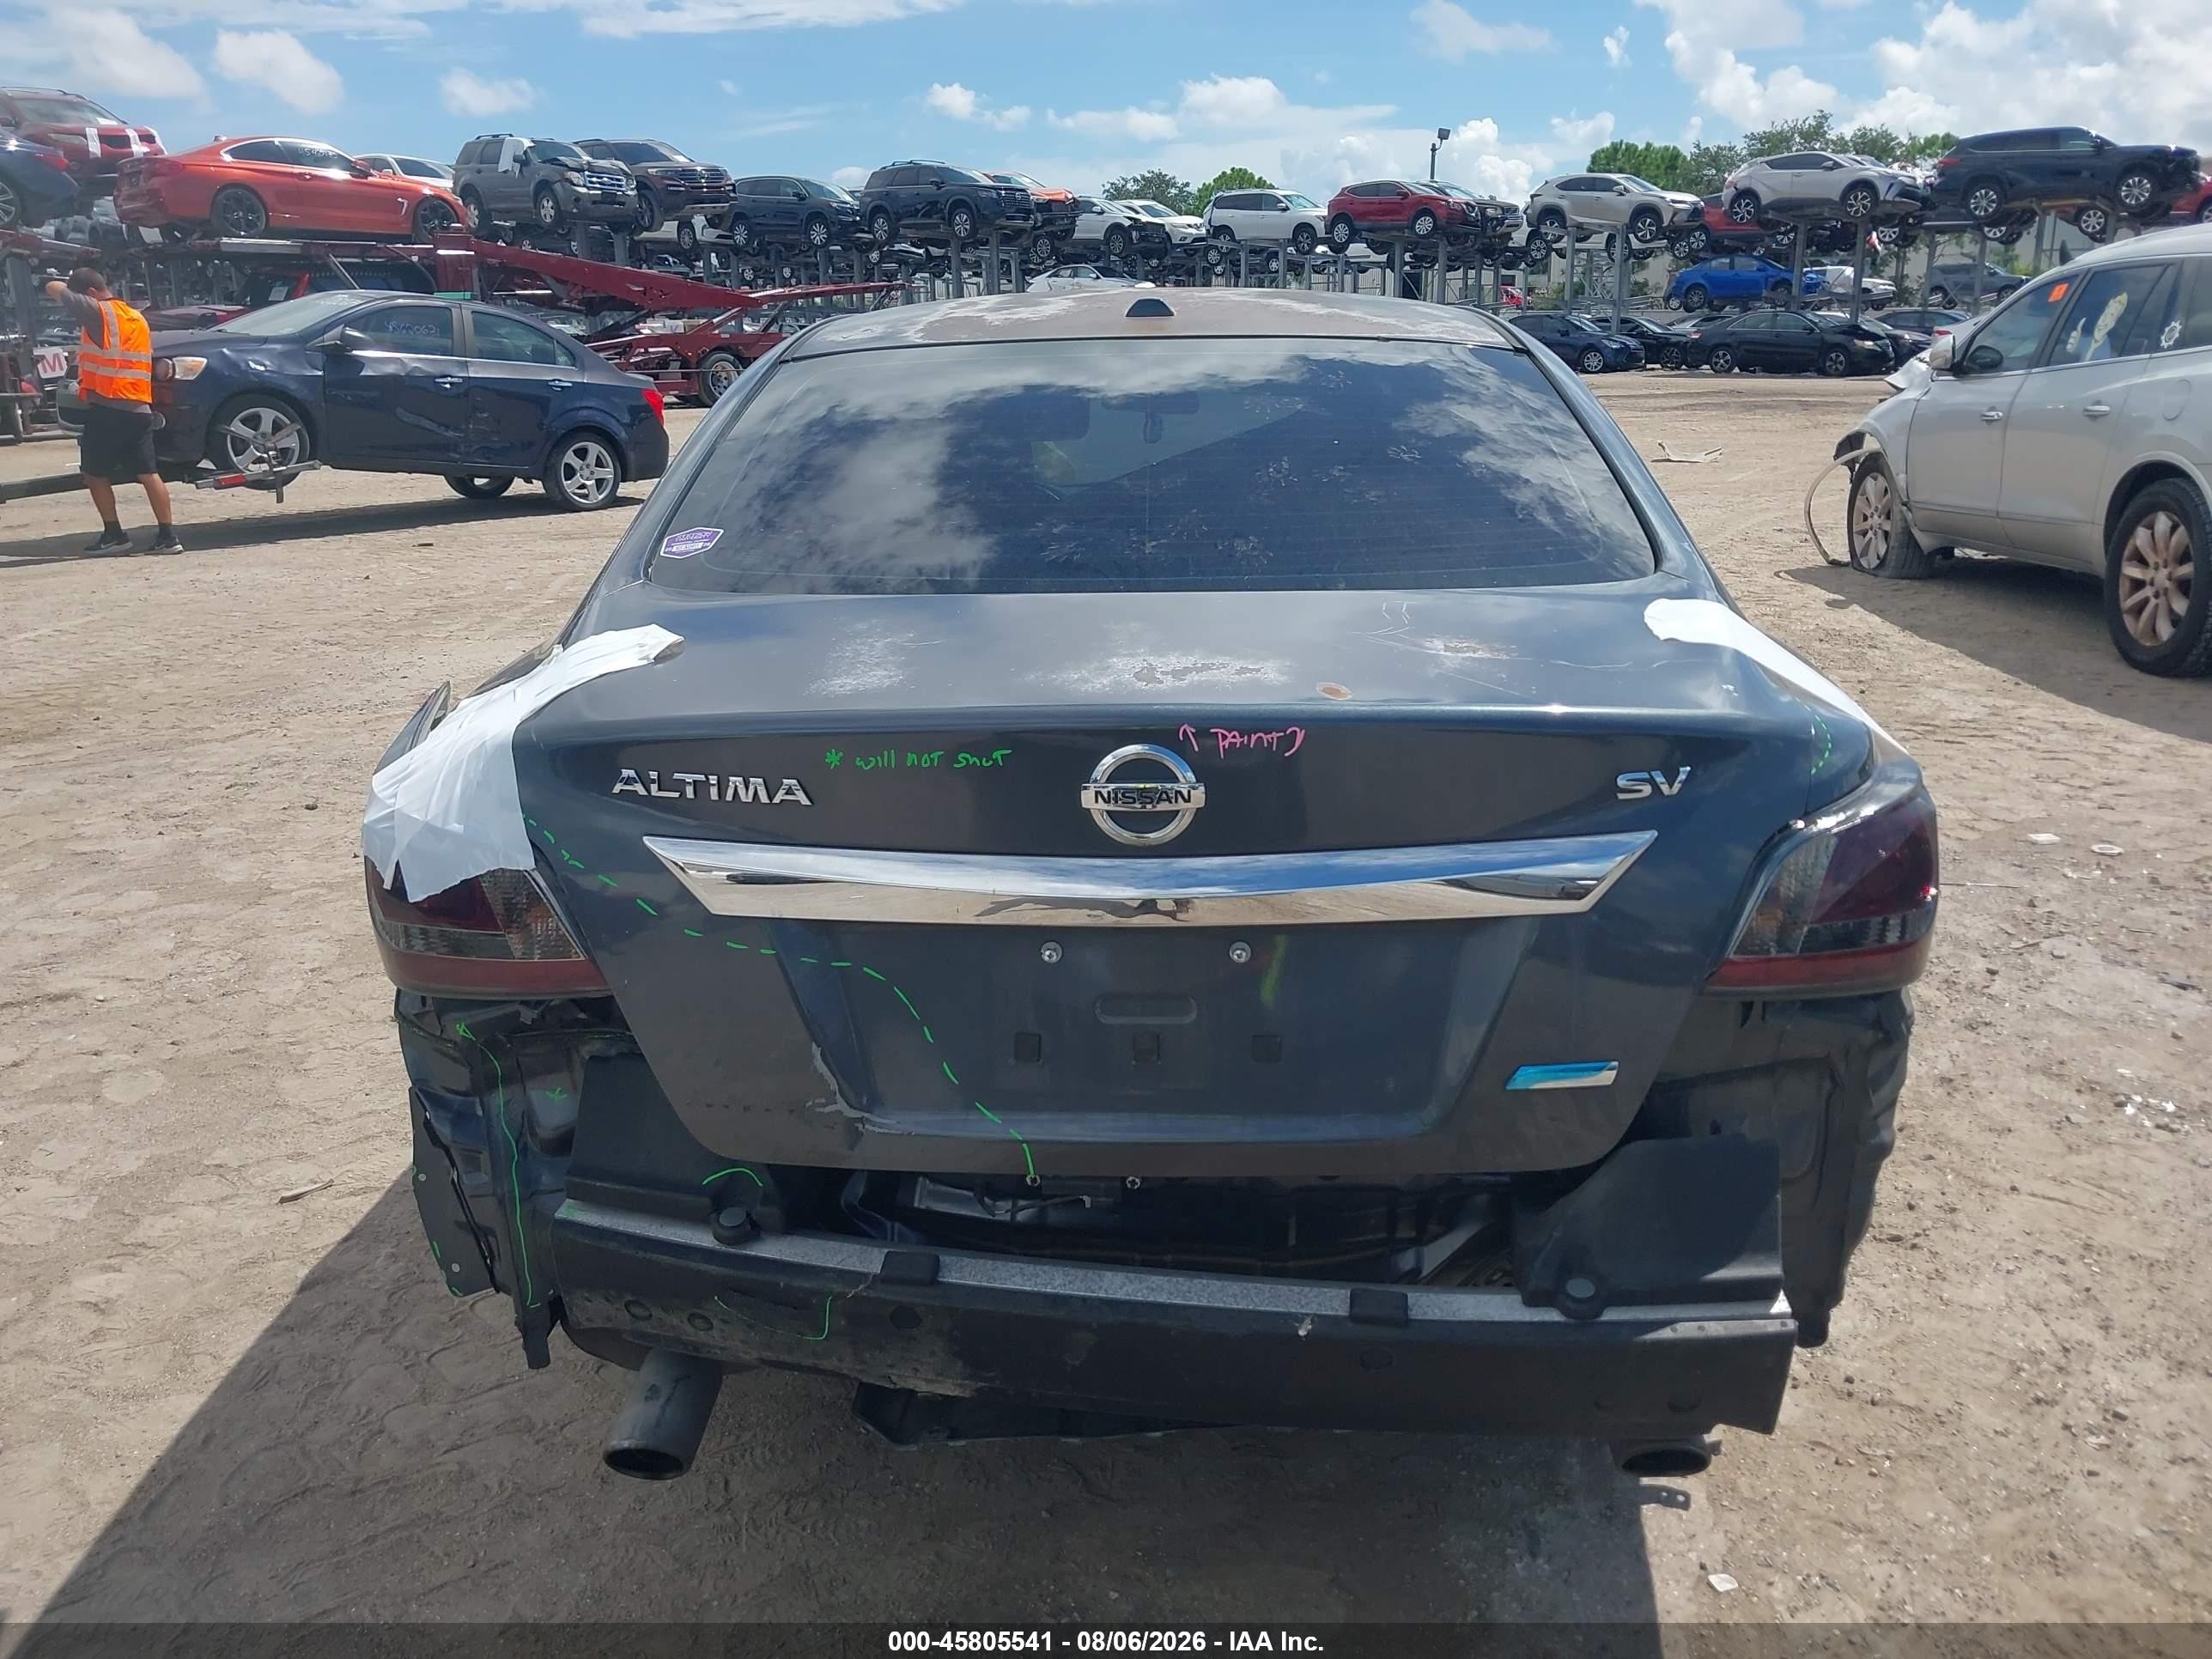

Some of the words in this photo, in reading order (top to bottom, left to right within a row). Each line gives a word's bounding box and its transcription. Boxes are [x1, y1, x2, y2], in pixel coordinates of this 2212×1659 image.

[855, 749, 896, 770] will
[611, 769, 814, 806] ALTIMA
[1616, 766, 1692, 799] SV
[1093, 789, 1192, 805] NISSAN
